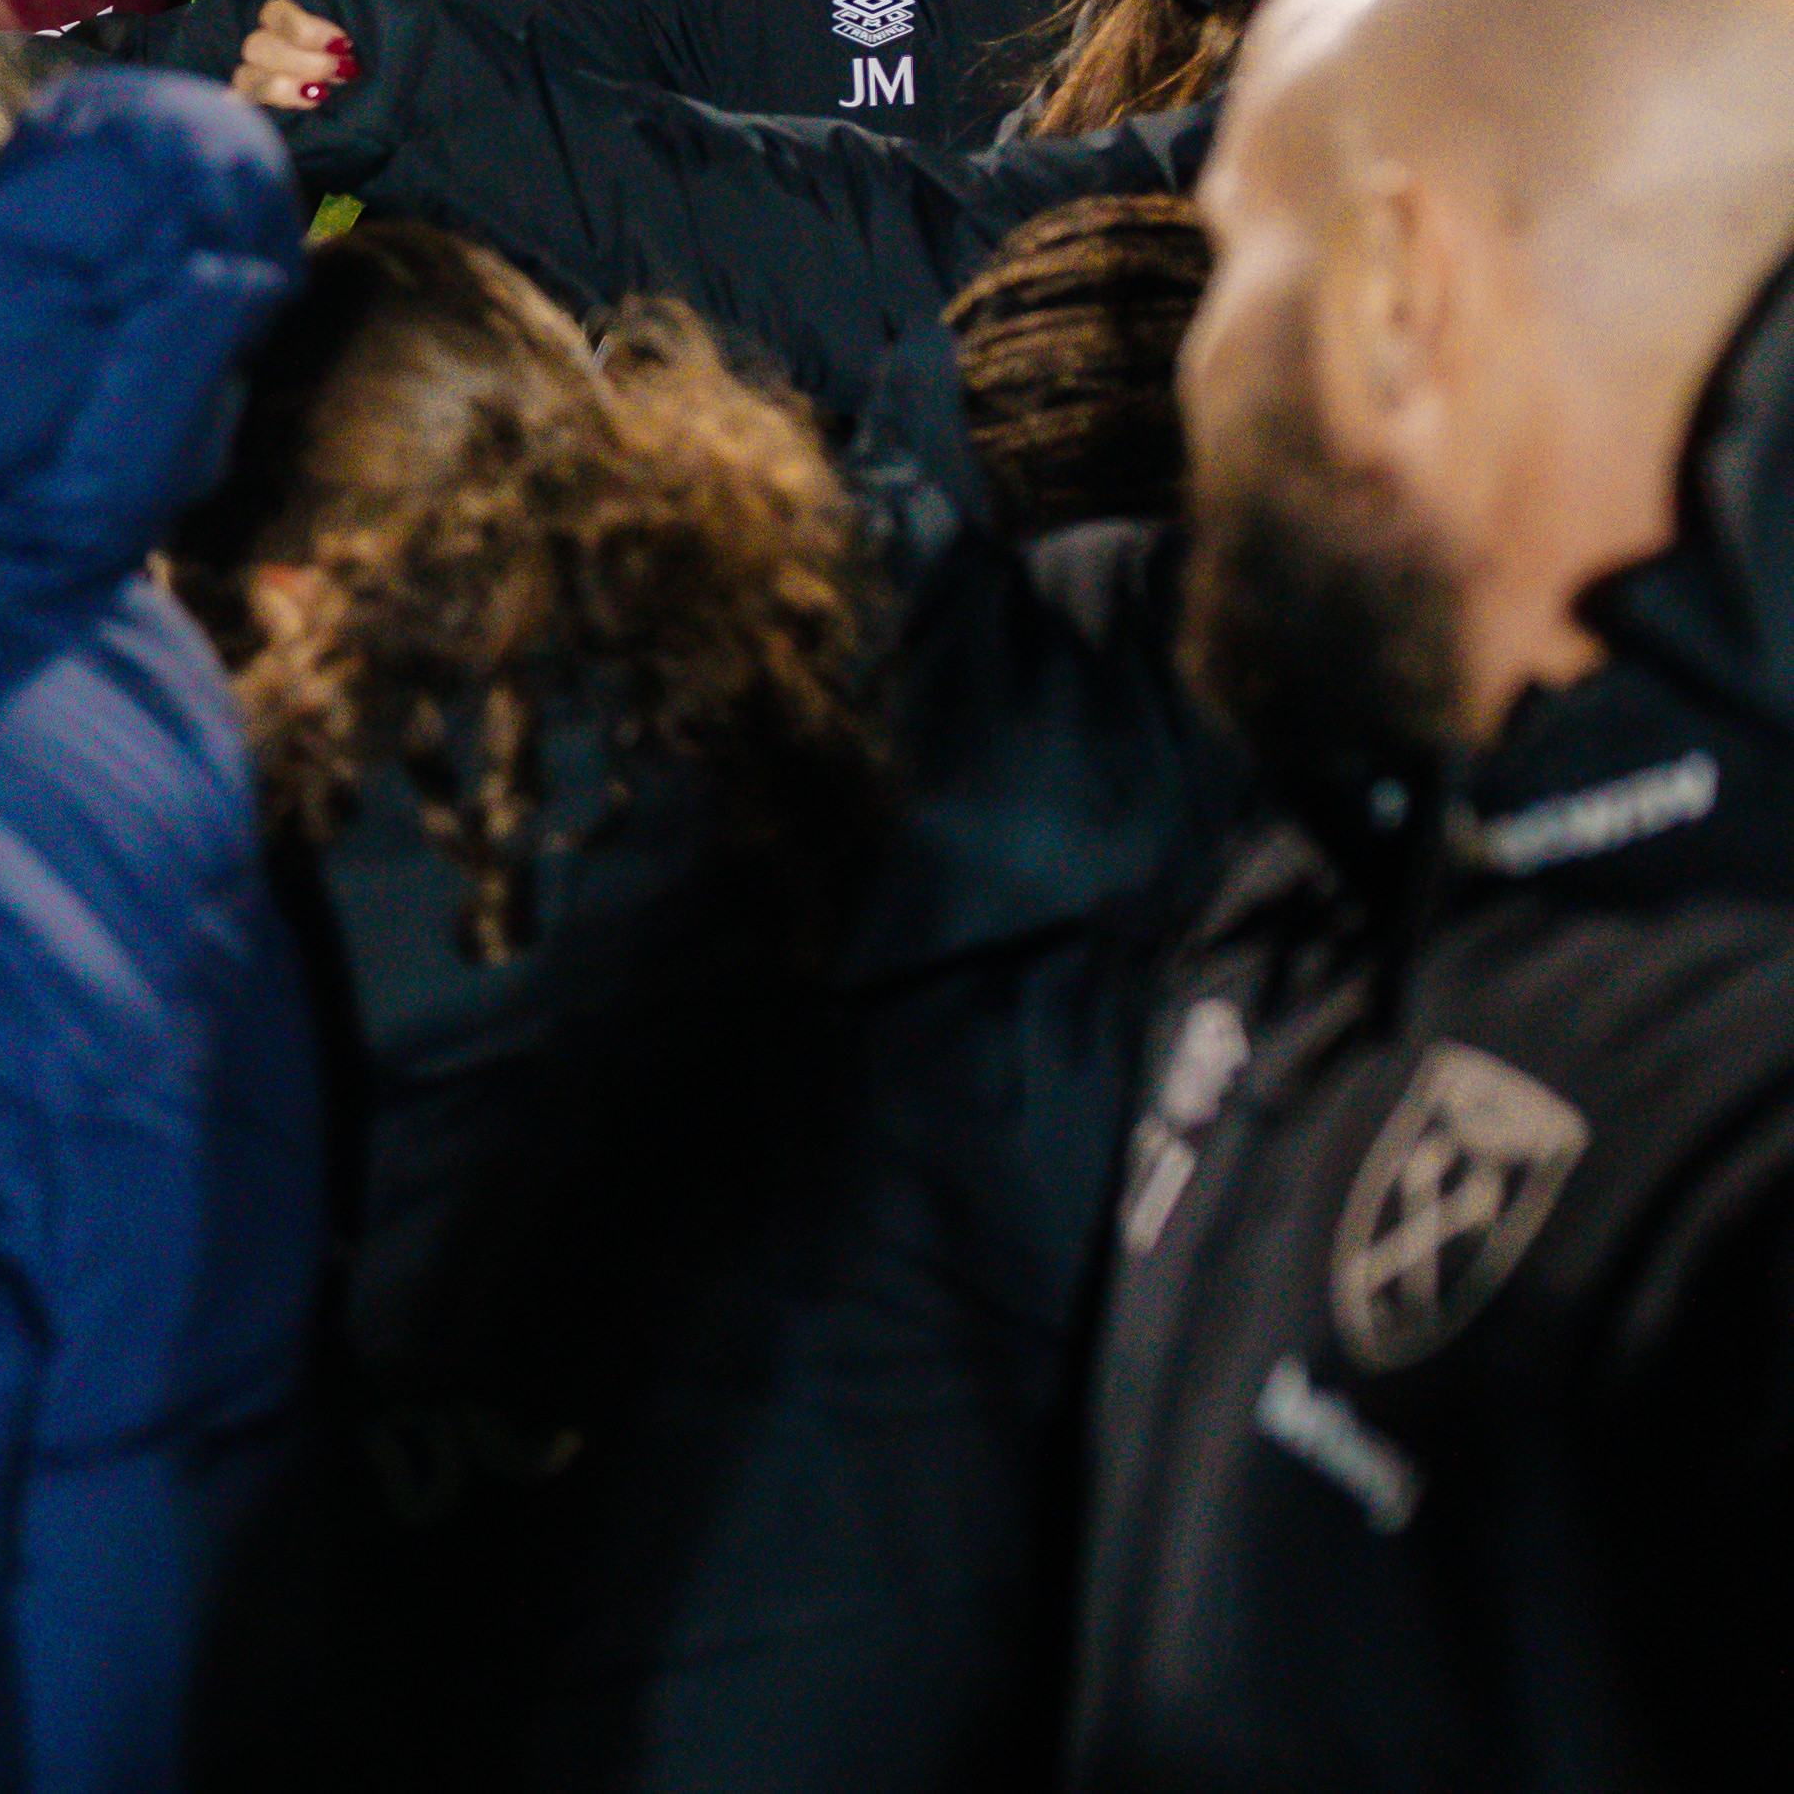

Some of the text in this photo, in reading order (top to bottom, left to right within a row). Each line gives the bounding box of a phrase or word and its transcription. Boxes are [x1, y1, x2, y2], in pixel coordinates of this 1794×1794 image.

[839, 9, 909, 28] PRO
[841, 23, 907, 43] TRAINING
[838, 55, 915, 108] JM
